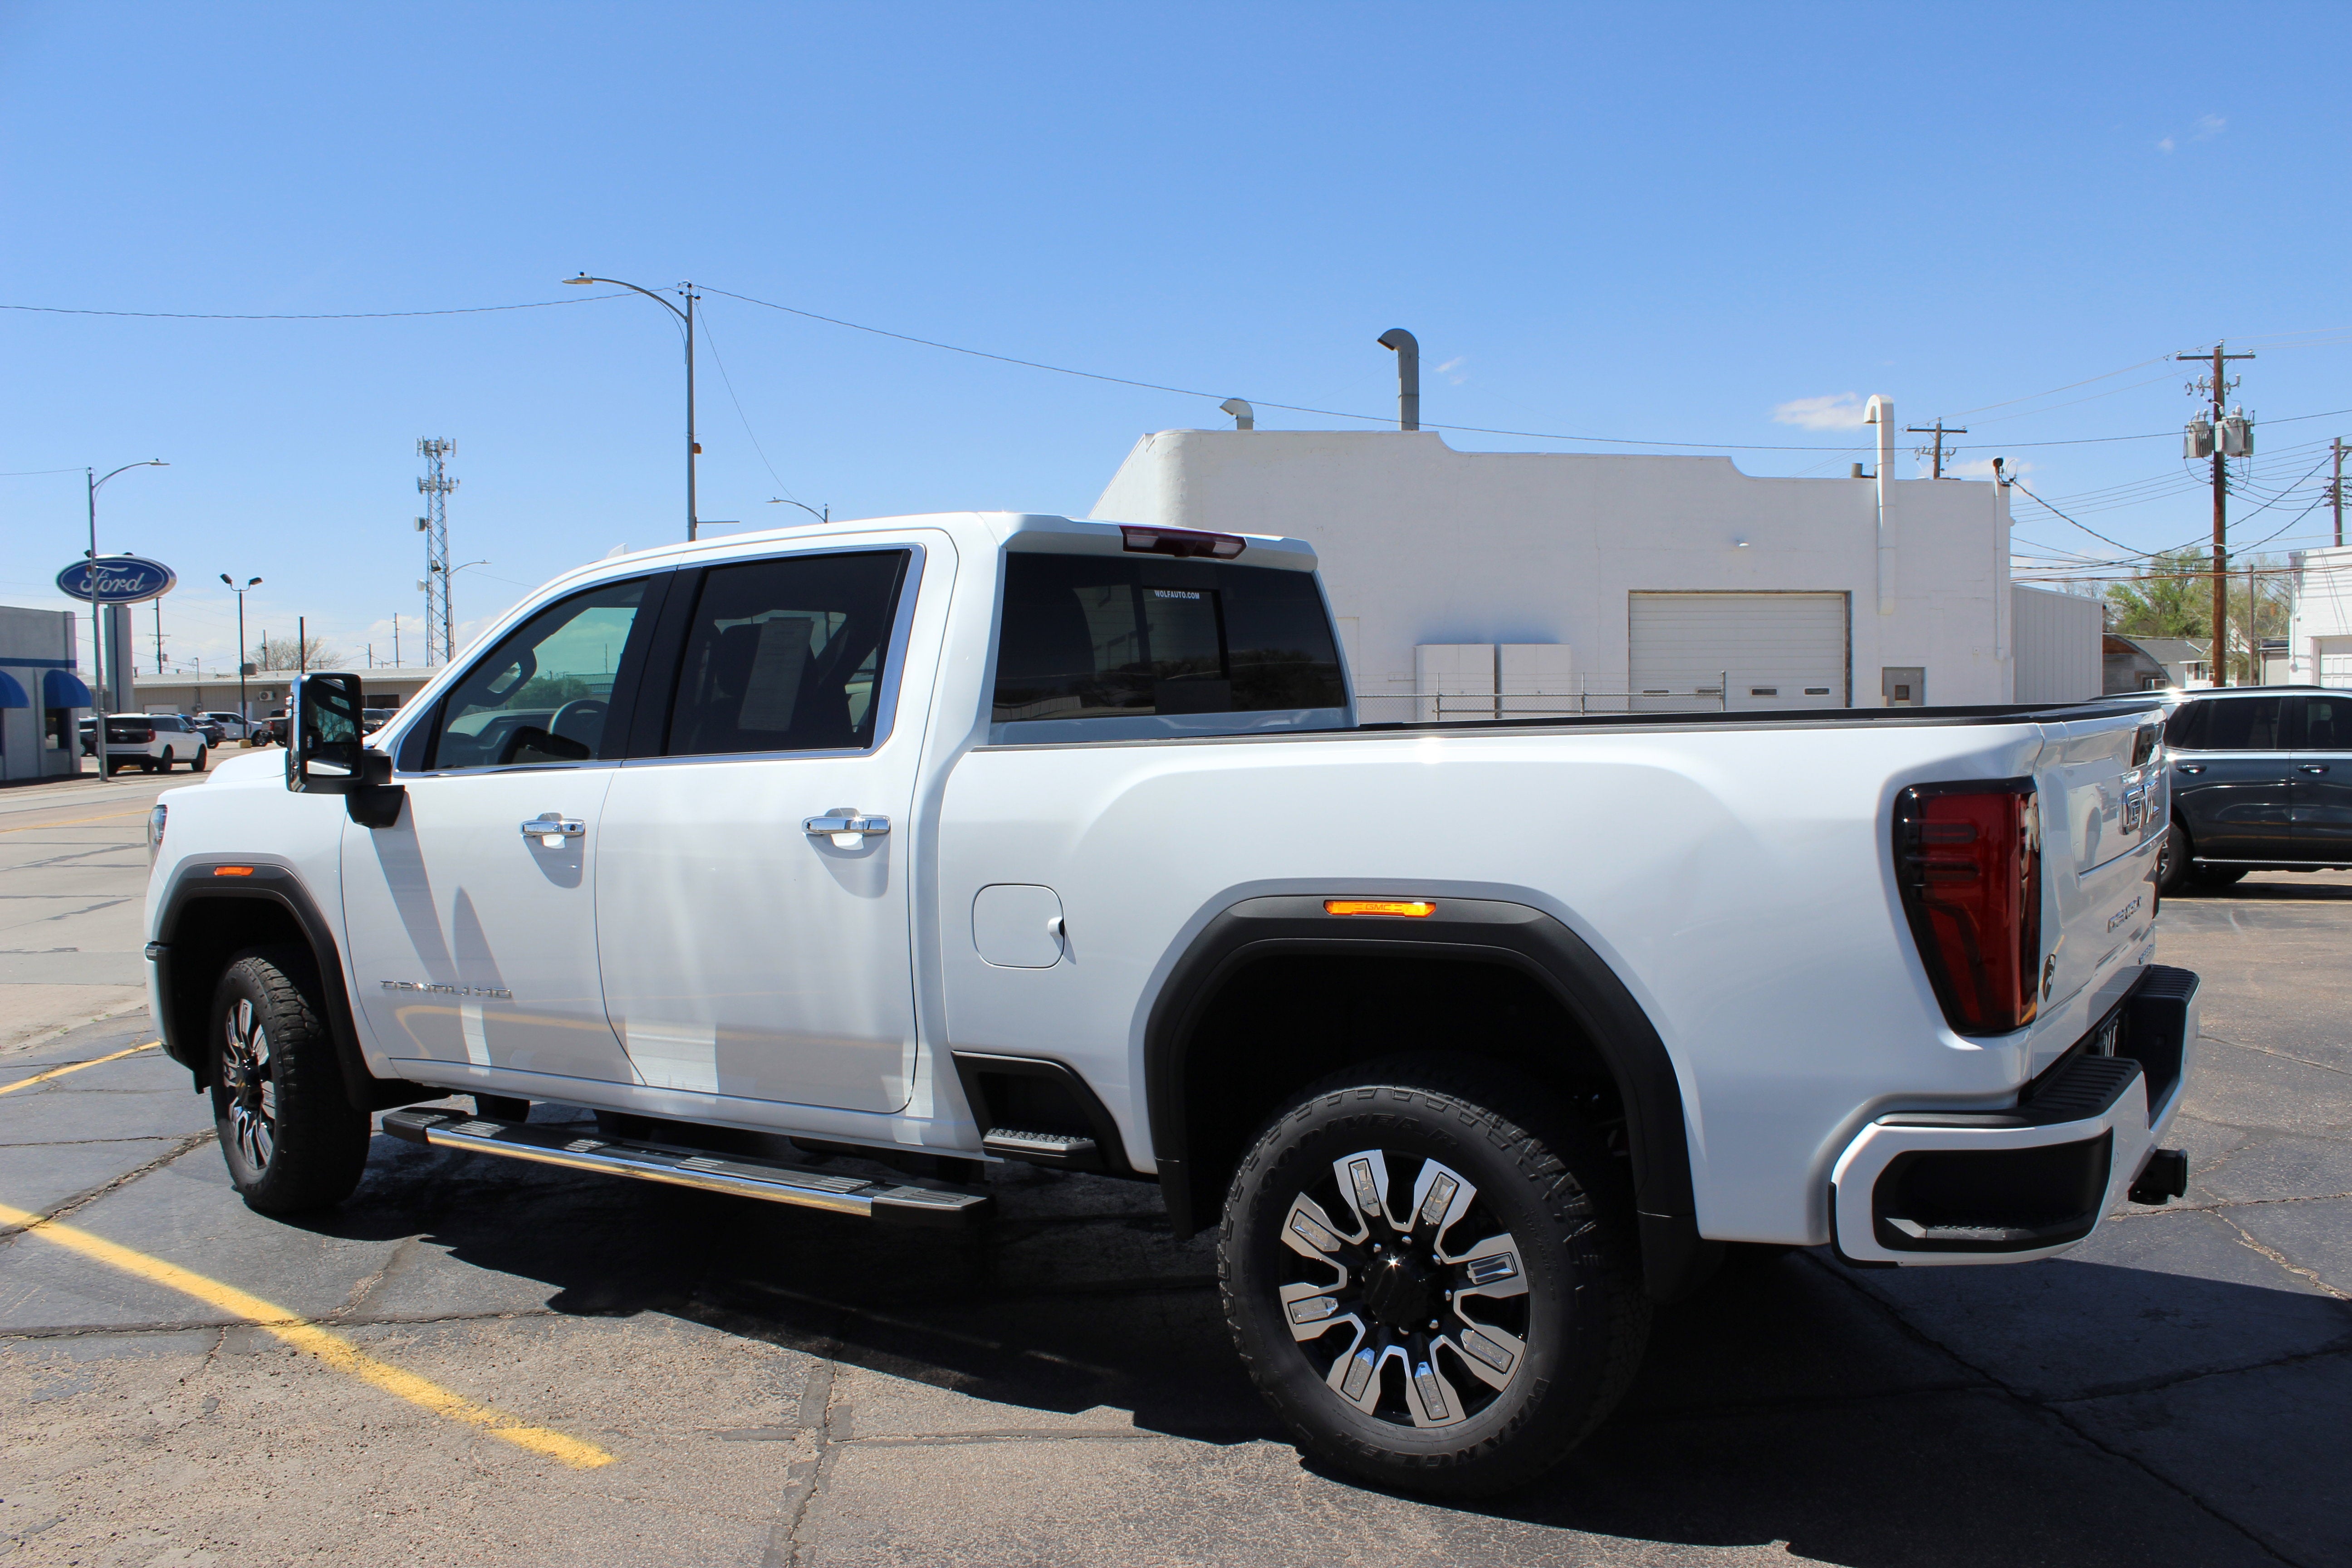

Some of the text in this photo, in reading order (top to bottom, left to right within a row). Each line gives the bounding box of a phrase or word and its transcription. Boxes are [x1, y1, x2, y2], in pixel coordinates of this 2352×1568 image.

[80, 566, 145, 593] Ford
[1154, 590, 1200, 599] WOLFAUTO.COM
[381, 980, 512, 999] DENALI HD
